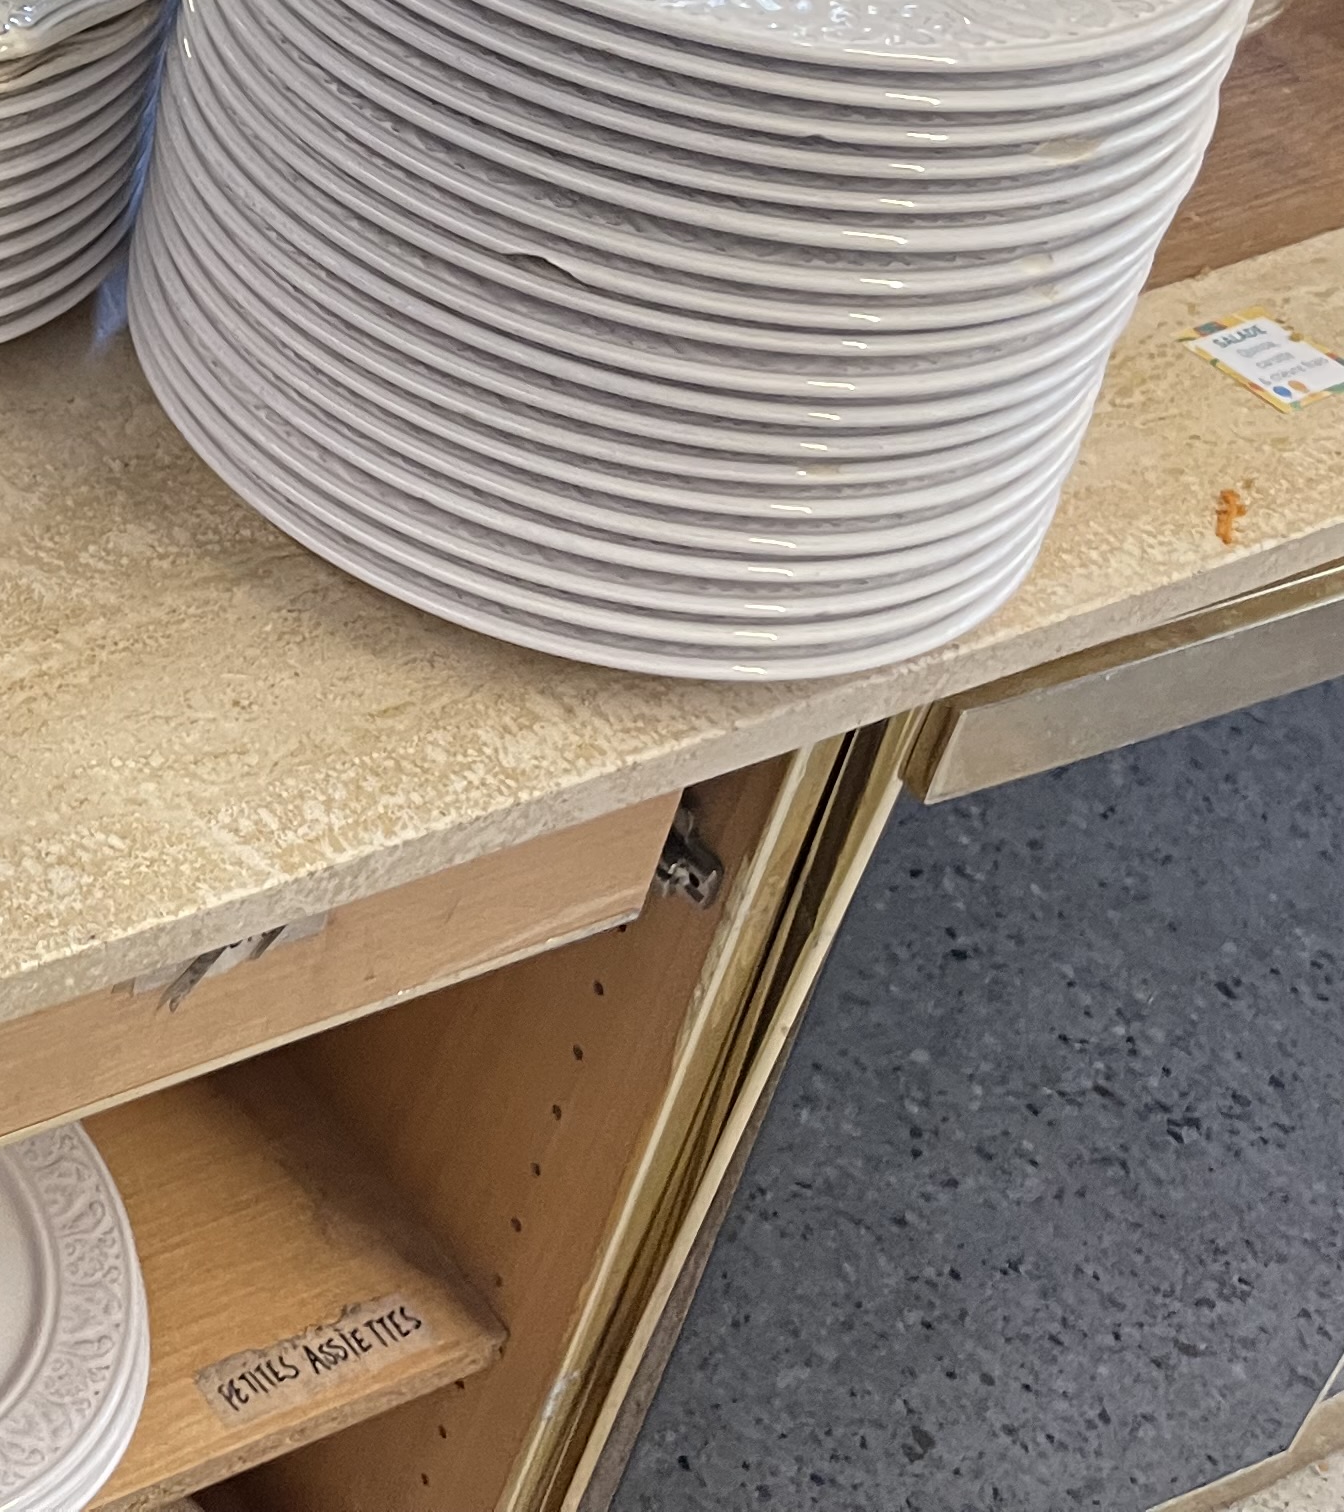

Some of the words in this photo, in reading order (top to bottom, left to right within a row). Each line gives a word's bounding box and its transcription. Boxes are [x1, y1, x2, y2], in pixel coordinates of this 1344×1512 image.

[1212, 324, 1267, 349] SALADE
[217, 1355, 300, 1412] PETITES
[302, 1306, 422, 1376] ASSIETTES
